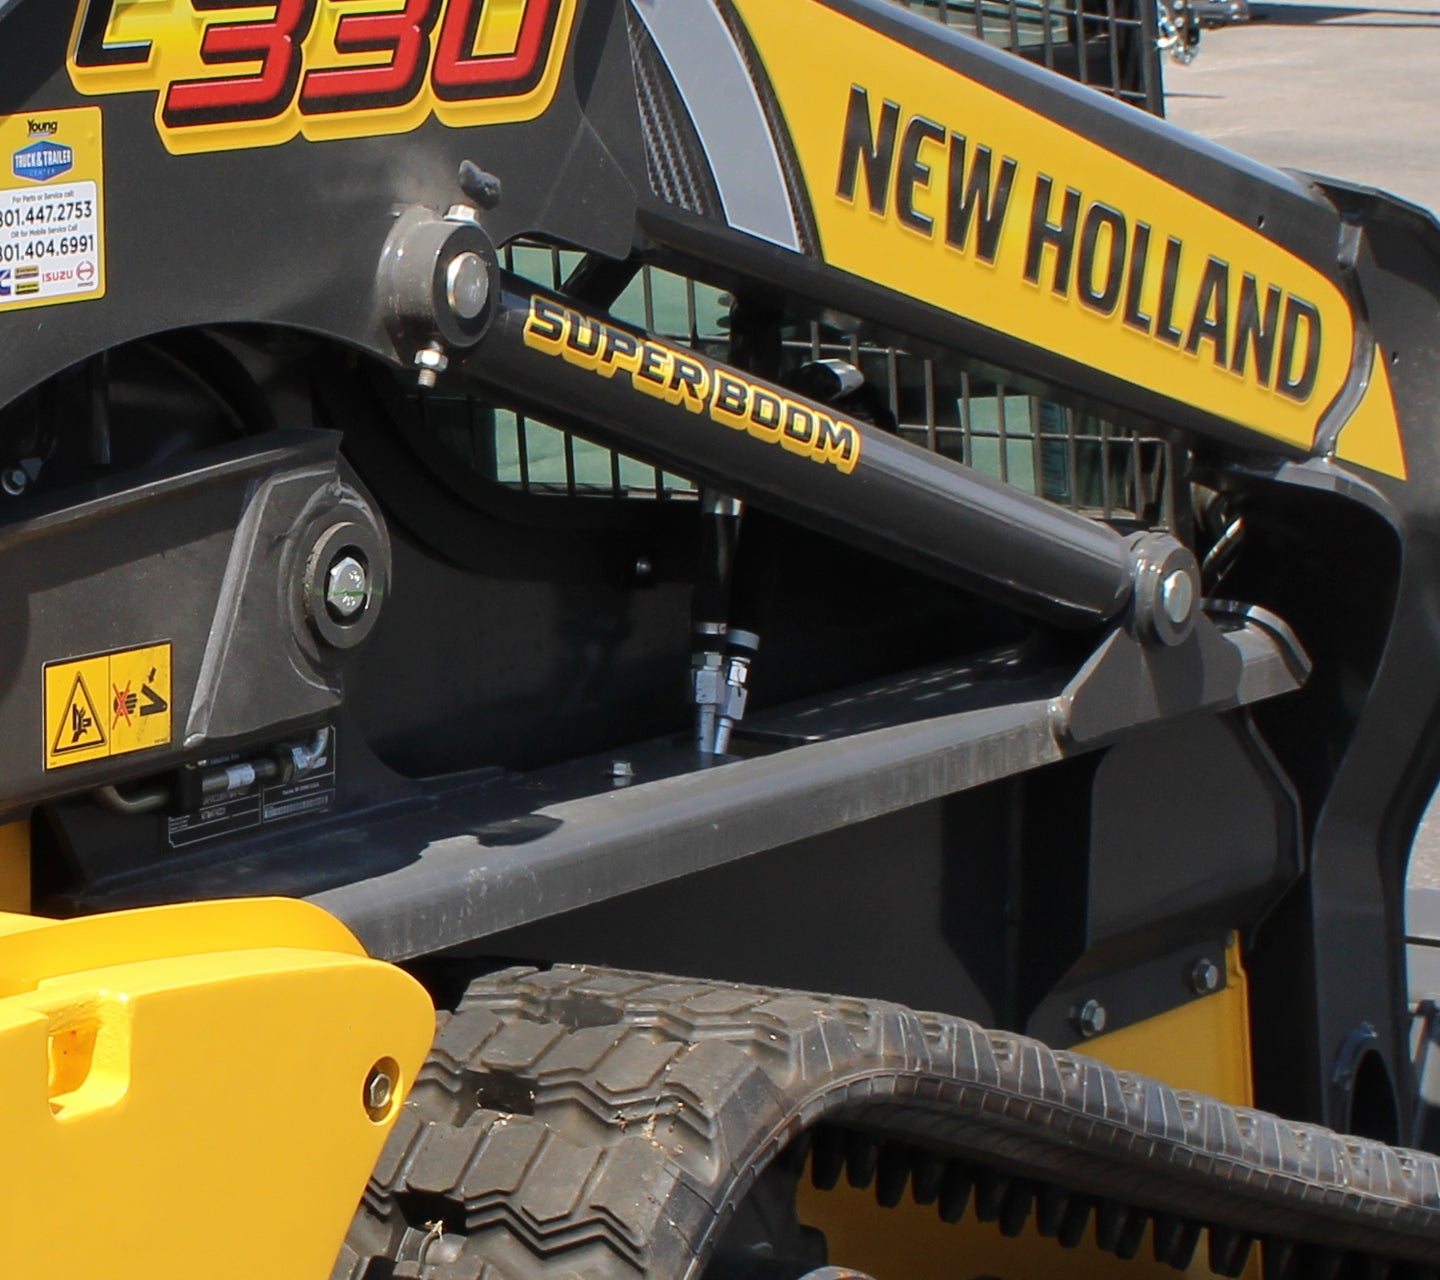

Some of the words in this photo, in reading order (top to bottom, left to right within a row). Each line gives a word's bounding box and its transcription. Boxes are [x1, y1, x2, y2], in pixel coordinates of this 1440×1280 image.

[27, 119, 58, 135] Young
[12, 196, 22, 204] For
[23, 194, 36, 202] Parts
[44, 191, 63, 199] Service
[29, 228, 47, 236] Mobile
[48, 225, 67, 234] Service
[68, 224, 78, 232] Call
[836, 83, 1018, 266] NEW
[1023, 173, 1322, 405] HOLLAND
[42, 269, 74, 283] ISUZU
[523, 294, 708, 414] SUPER
[710, 372, 862, 475] BOOM
